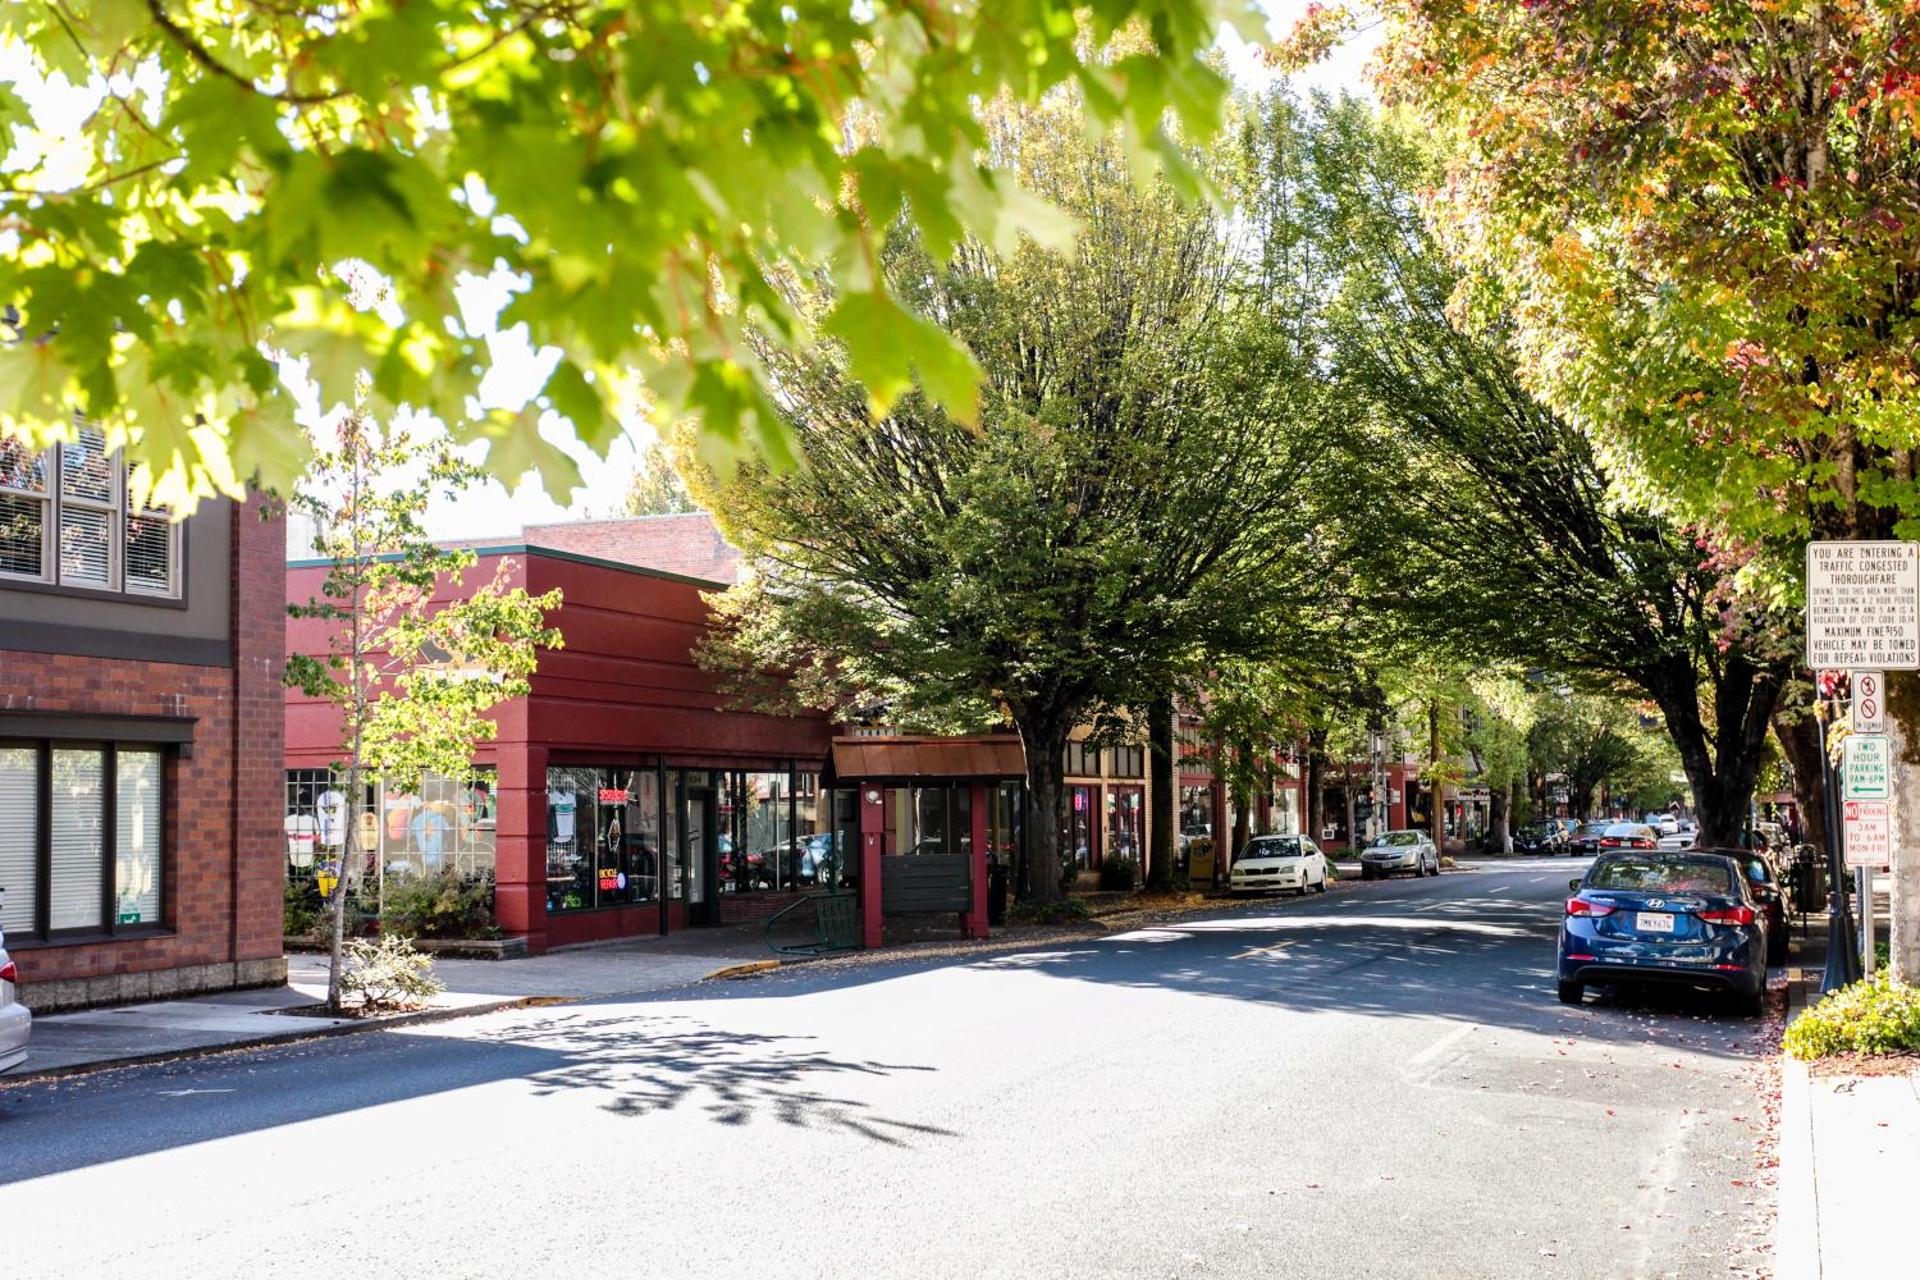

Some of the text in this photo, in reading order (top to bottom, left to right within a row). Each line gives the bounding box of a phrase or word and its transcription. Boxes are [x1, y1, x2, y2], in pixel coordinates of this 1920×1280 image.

[1813, 548, 1914, 559] YOU ARE ENTERING A
[1819, 561, 1908, 572] TRAFFIC CONGESTED
[1830, 574, 1897, 585] THOROUGHFARE
[1824, 626, 1862, 637] MAXIMUM
[1867, 626, 1883, 637] FINE
[1813, 639, 1916, 650] VEHICLE MAY BE TOWED
[1813, 652, 1916, 663] FOR REPEAT VIOLATIONS
[1857, 742, 1875, 751] TWO
[1853, 753, 1880, 762] HOUR
[1849, 764, 1885, 772] PARKING
[1845, 805, 1858, 817] NO
[1850, 834, 1861, 842] TO
